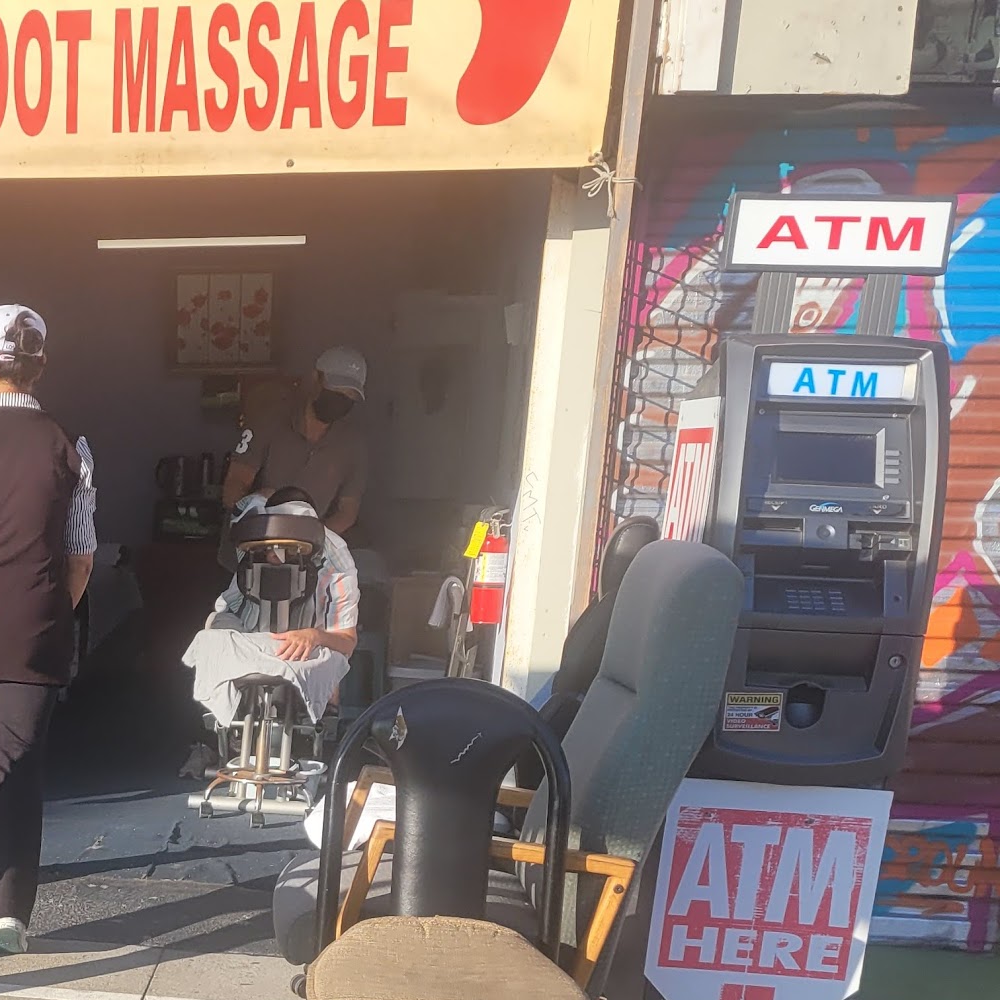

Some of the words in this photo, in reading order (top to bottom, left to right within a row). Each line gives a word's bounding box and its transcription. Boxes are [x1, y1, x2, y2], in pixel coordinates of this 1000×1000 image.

[112, 0, 414, 134] MASSAGE
[756, 214, 926, 252] ATM
[791, 367, 879, 398] ATM
[235, 428, 254, 454] 3
[668, 821, 857, 929] ATM
[667, 924, 844, 974] HERE
